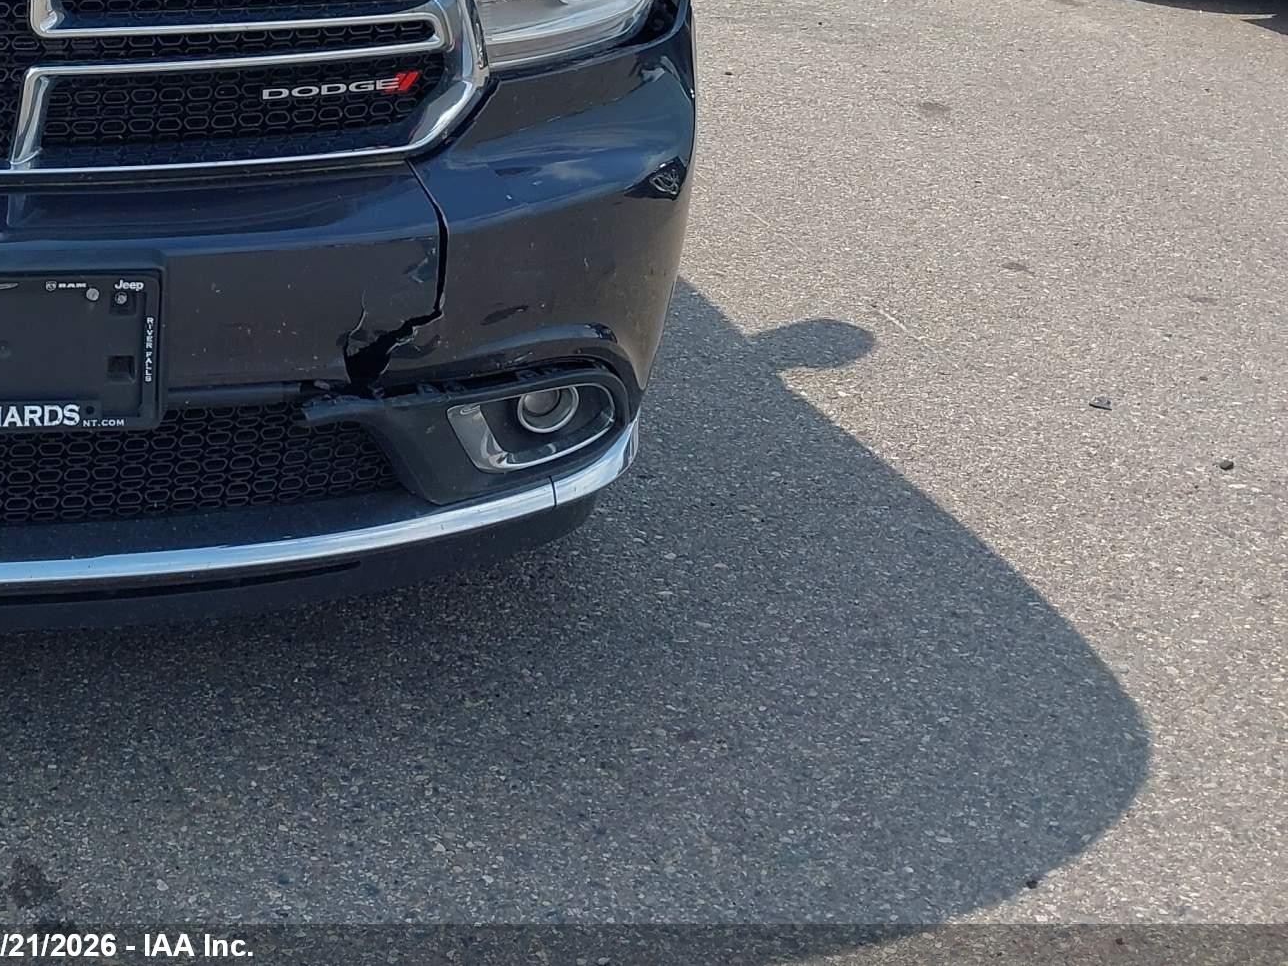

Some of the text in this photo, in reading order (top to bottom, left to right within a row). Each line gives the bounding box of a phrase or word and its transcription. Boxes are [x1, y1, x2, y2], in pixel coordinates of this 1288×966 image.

[262, 77, 400, 100] DODGE
[114, 279, 144, 292] Jeep
[144, 317, 154, 382] RIVER FALLS
